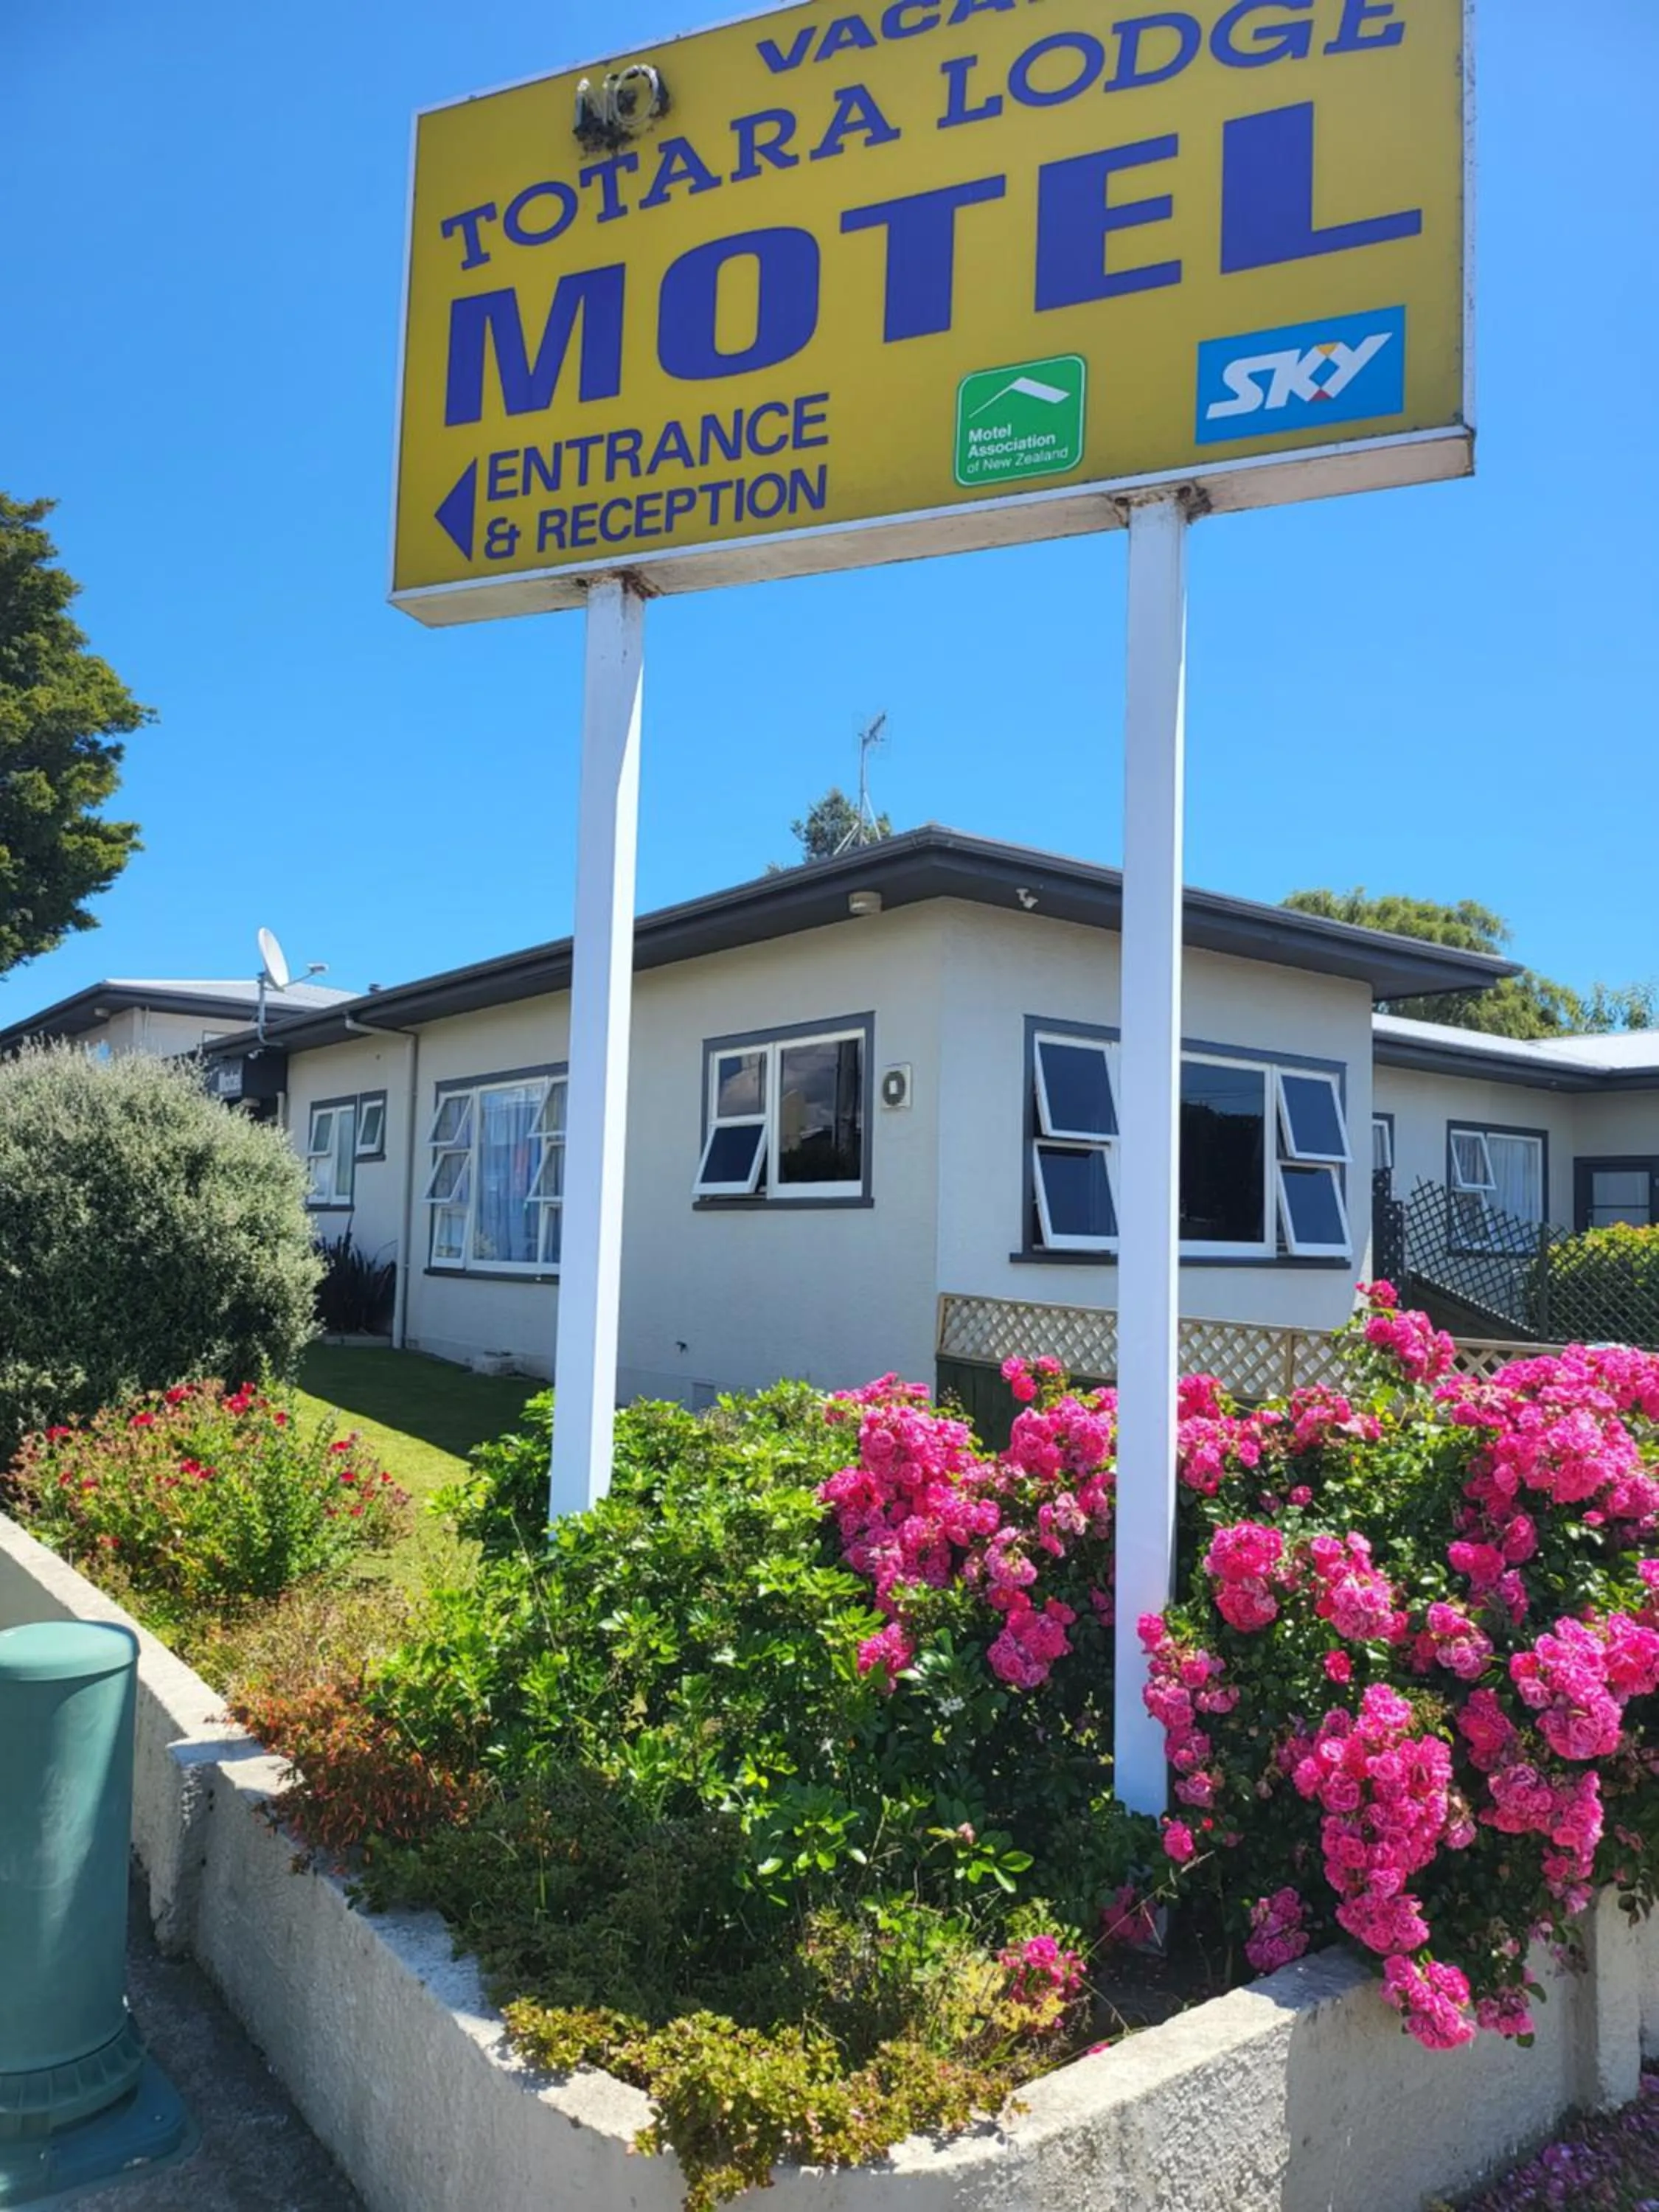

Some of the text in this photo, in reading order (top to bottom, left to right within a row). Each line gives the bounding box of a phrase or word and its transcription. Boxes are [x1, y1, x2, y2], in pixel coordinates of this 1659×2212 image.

[756, 0, 1041, 72] VACA
[575, 63, 658, 126] NO
[442, 0, 1405, 271] TOTARA LODGE
[445, 101, 1422, 426] MOTEL
[1206, 333, 1393, 419] SKY
[487, 392, 829, 501] ENTRANCE
[967, 447, 1068, 473] of New Zealand
[968, 423, 1012, 442] Motel
[968, 434, 1056, 458] Association
[484, 465, 827, 560] & RECEPTION
